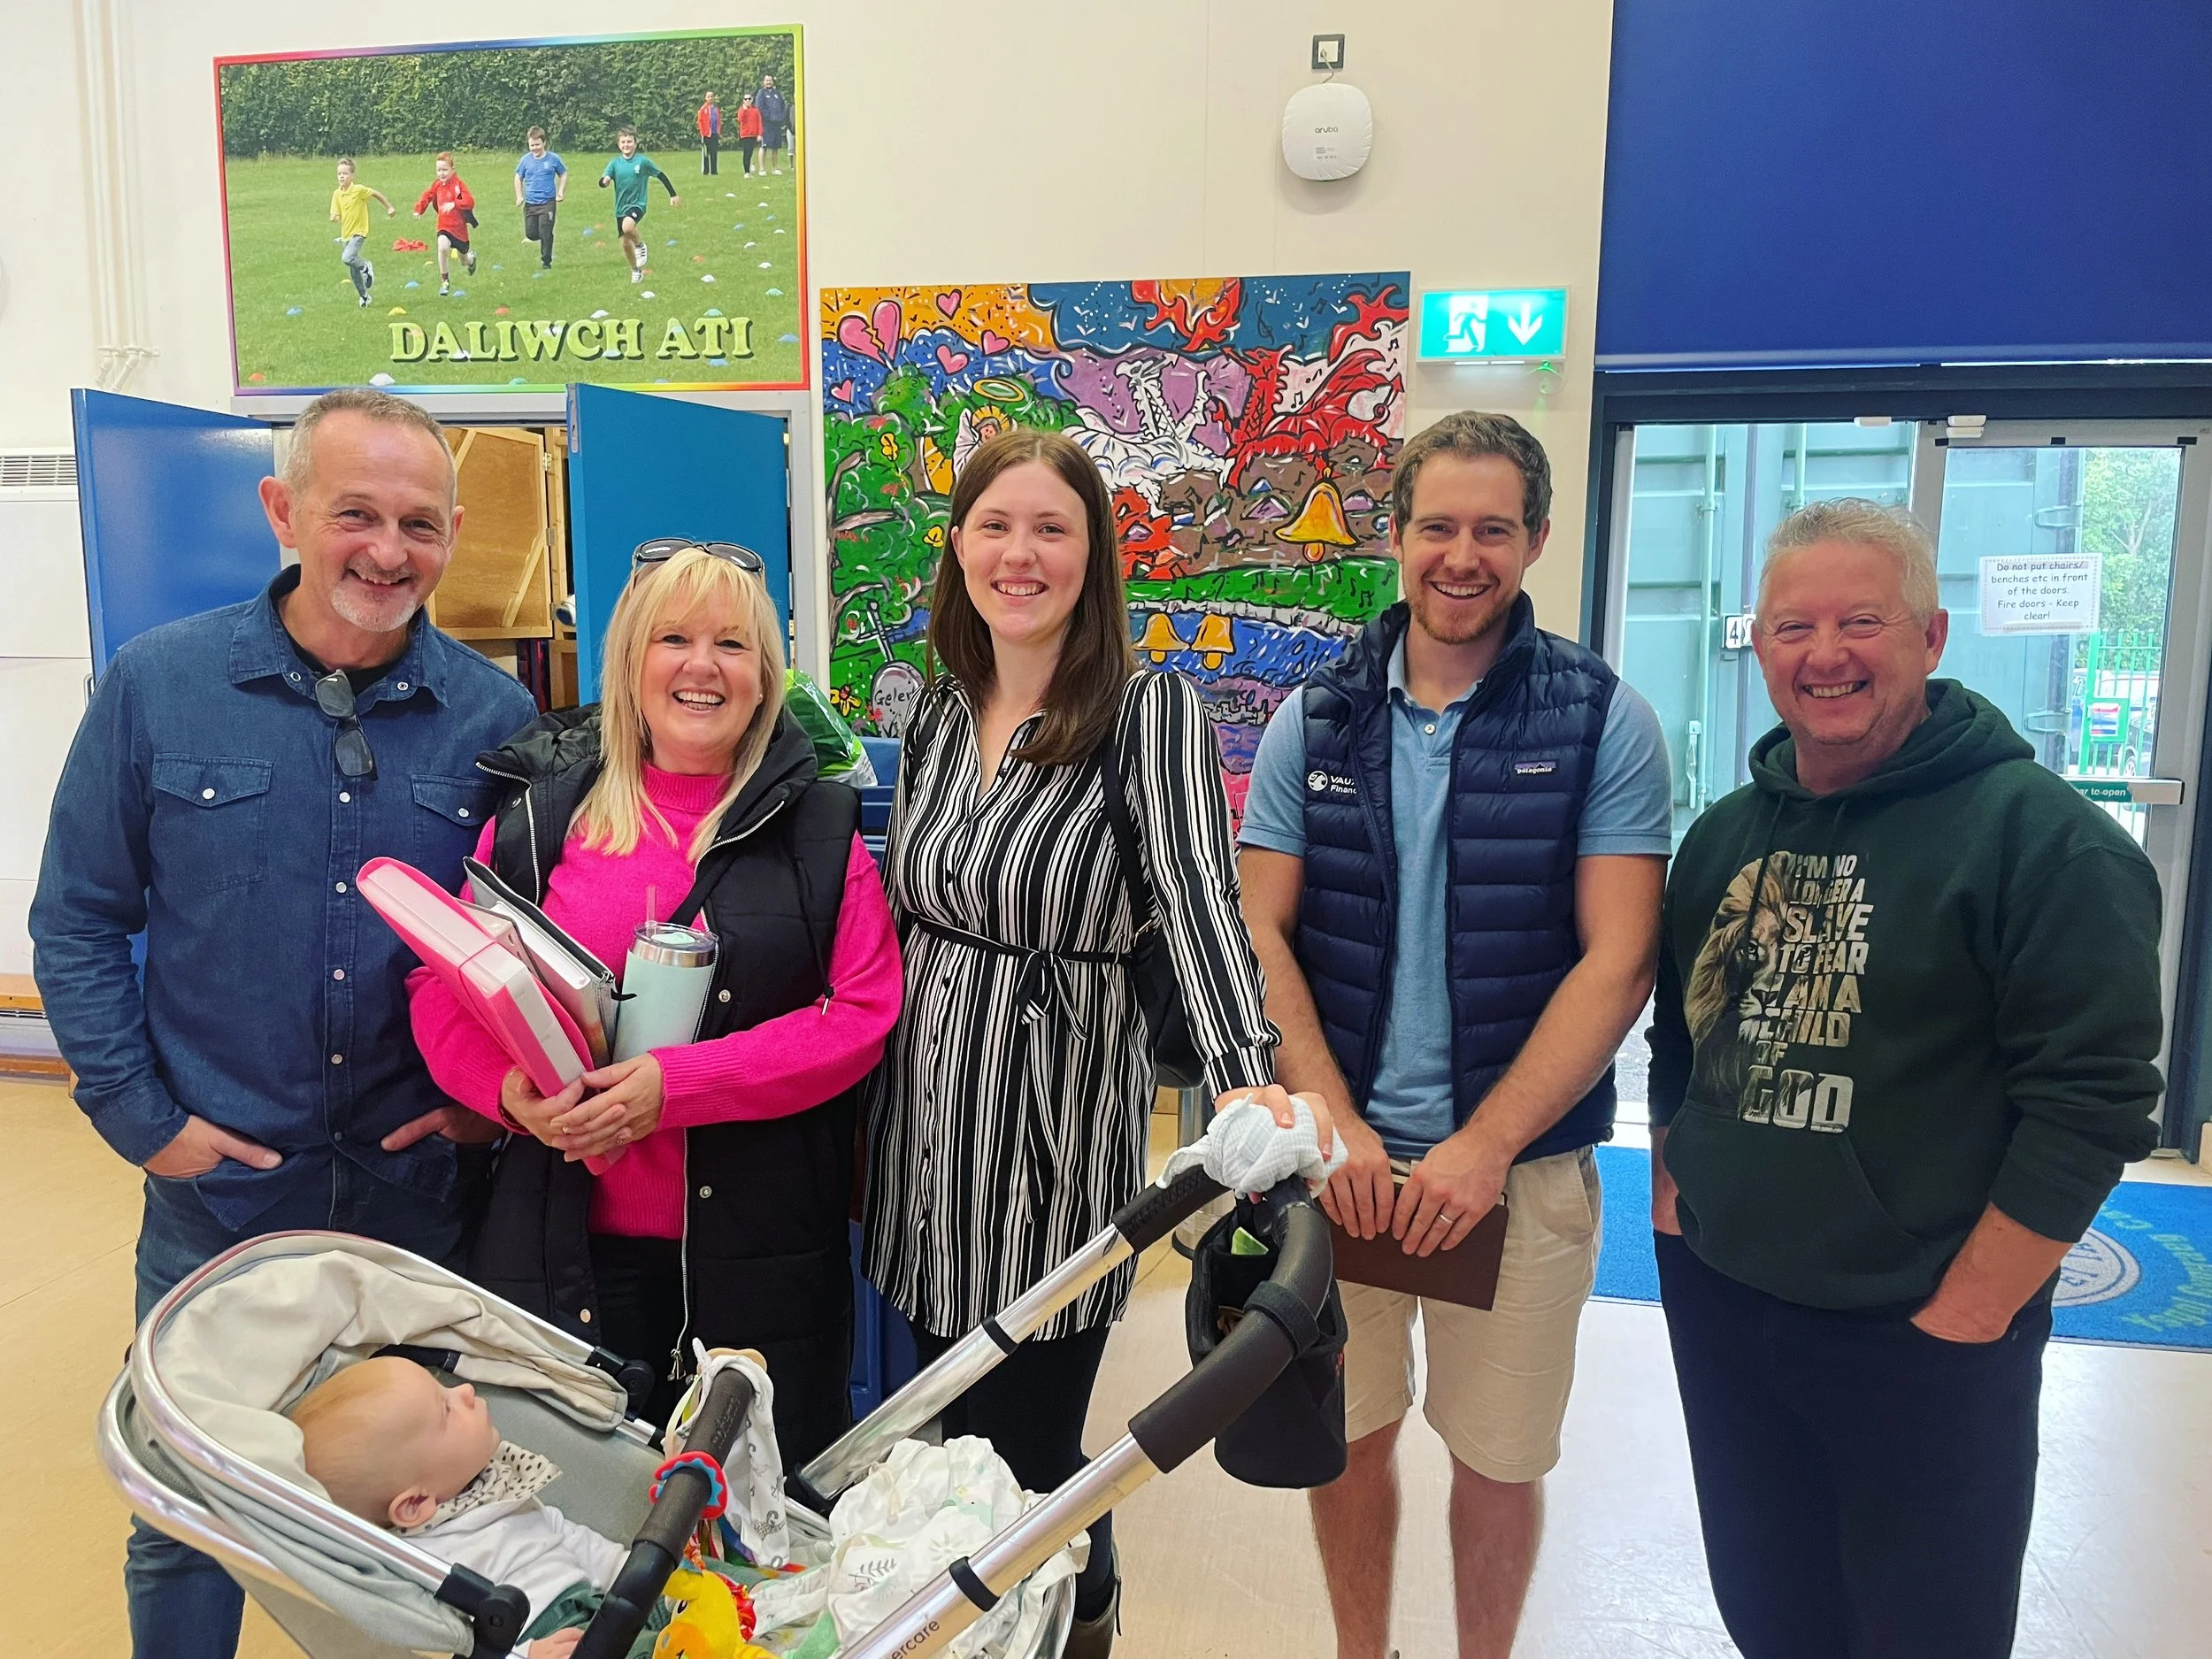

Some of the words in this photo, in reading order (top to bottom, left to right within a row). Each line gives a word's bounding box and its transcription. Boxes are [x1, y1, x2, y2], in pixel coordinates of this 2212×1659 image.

[388, 319, 644, 362] DALIWCH
[656, 317, 754, 359] ATI
[1996, 563, 2009, 572] Do
[2031, 562, 2046, 572] put
[2049, 560, 2084, 570] chairs/
[2062, 572, 2088, 582] front
[1997, 600, 2016, 609] Fire
[2019, 599, 2046, 608] doors
[2056, 599, 2079, 609] Keep
[2008, 587, 2018, 595] of
[2040, 586, 2070, 595] doors.
[2024, 611, 2050, 620] clear!
[1330, 784, 1357, 795] Financ
[1832, 855, 1857, 878] NO
[1790, 878, 1853, 907] LONGER
[1849, 878, 1865, 902] A
[1783, 902, 1874, 943] SLAVE
[1778, 943, 1812, 974] TO
[1812, 941, 1870, 975] FEAR
[1783, 974, 1832, 1010] AM
[1833, 974, 1862, 1013] A
[1758, 1007, 1850, 1047] CHILD
[1755, 1040, 1788, 1066] OF
[1741, 1064, 1854, 1133] GOD
[887, 1621, 940, 1659] ercare
